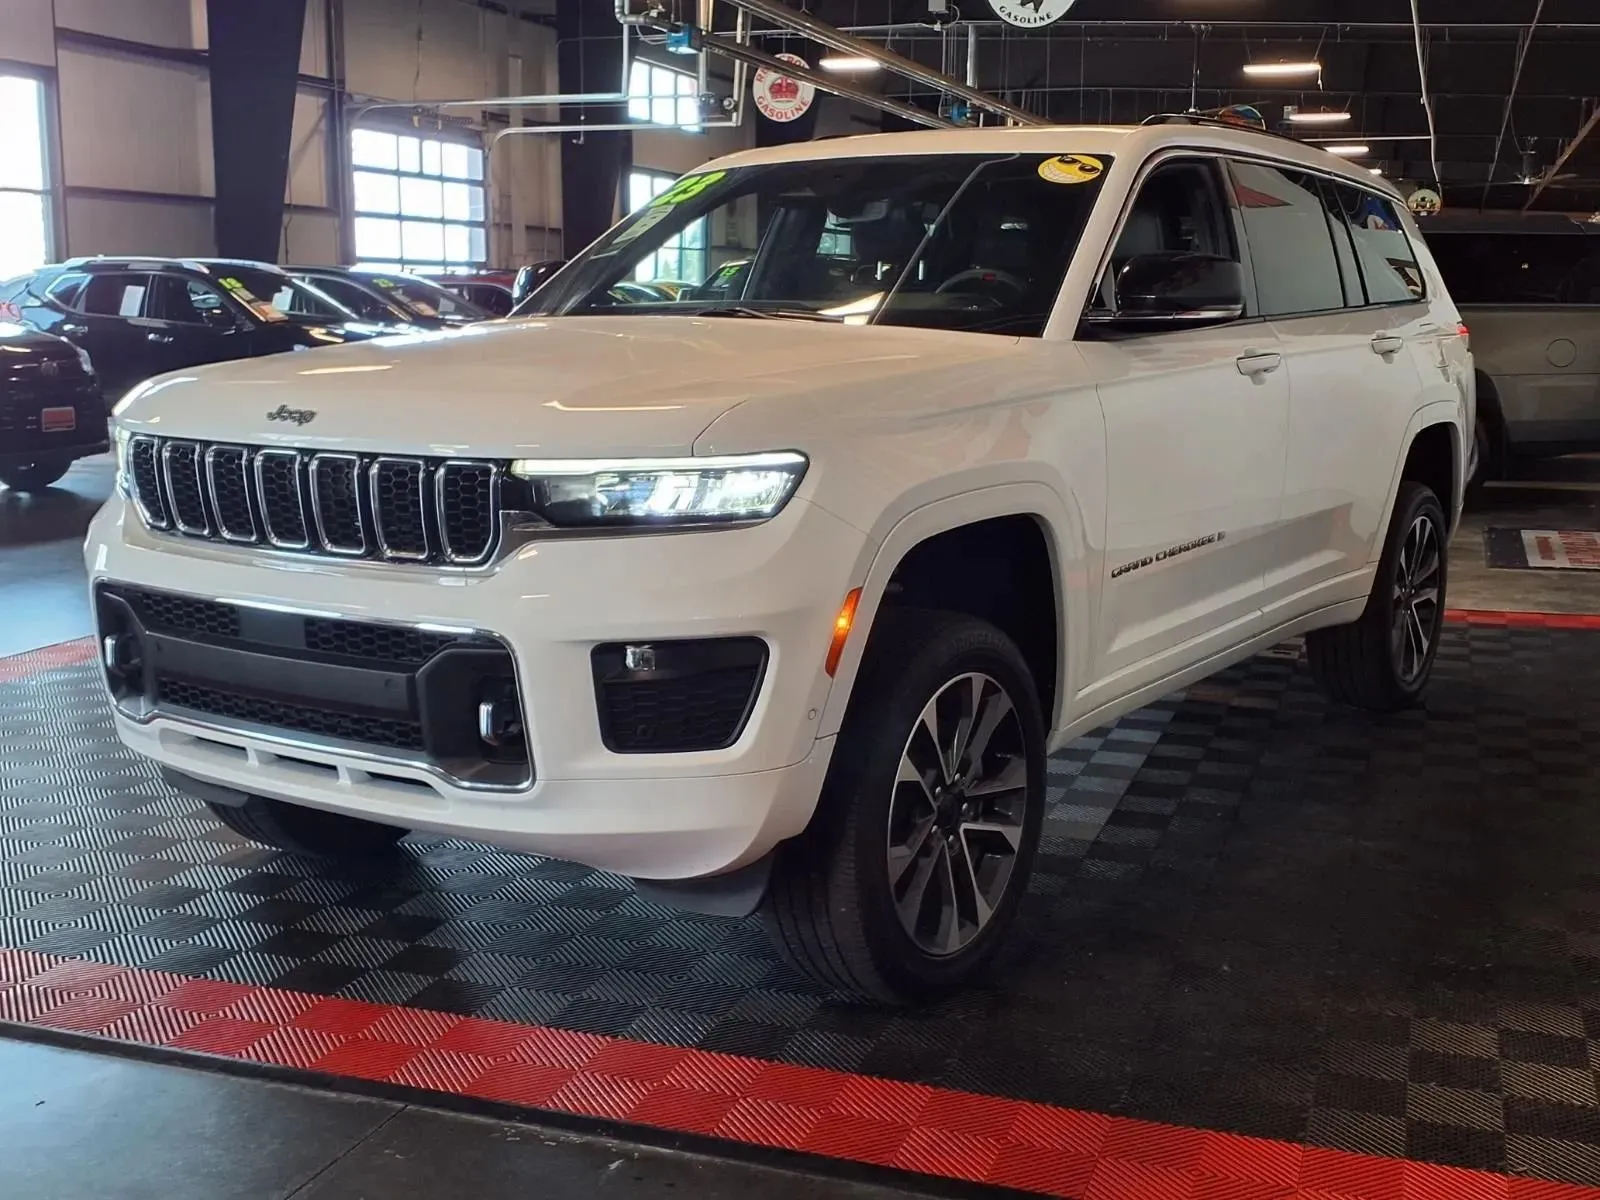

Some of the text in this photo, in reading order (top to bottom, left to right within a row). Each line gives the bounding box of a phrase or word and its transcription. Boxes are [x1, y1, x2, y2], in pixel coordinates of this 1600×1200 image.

[999, 5, 1053, 24] GASOLINE
[757, 95, 809, 120] GASOLINE
[647, 170, 727, 208] 23
[266, 404, 318, 427] Jeep
[1111, 556, 1154, 578] GRAND
[1155, 533, 1216, 562] CHEROKEE
